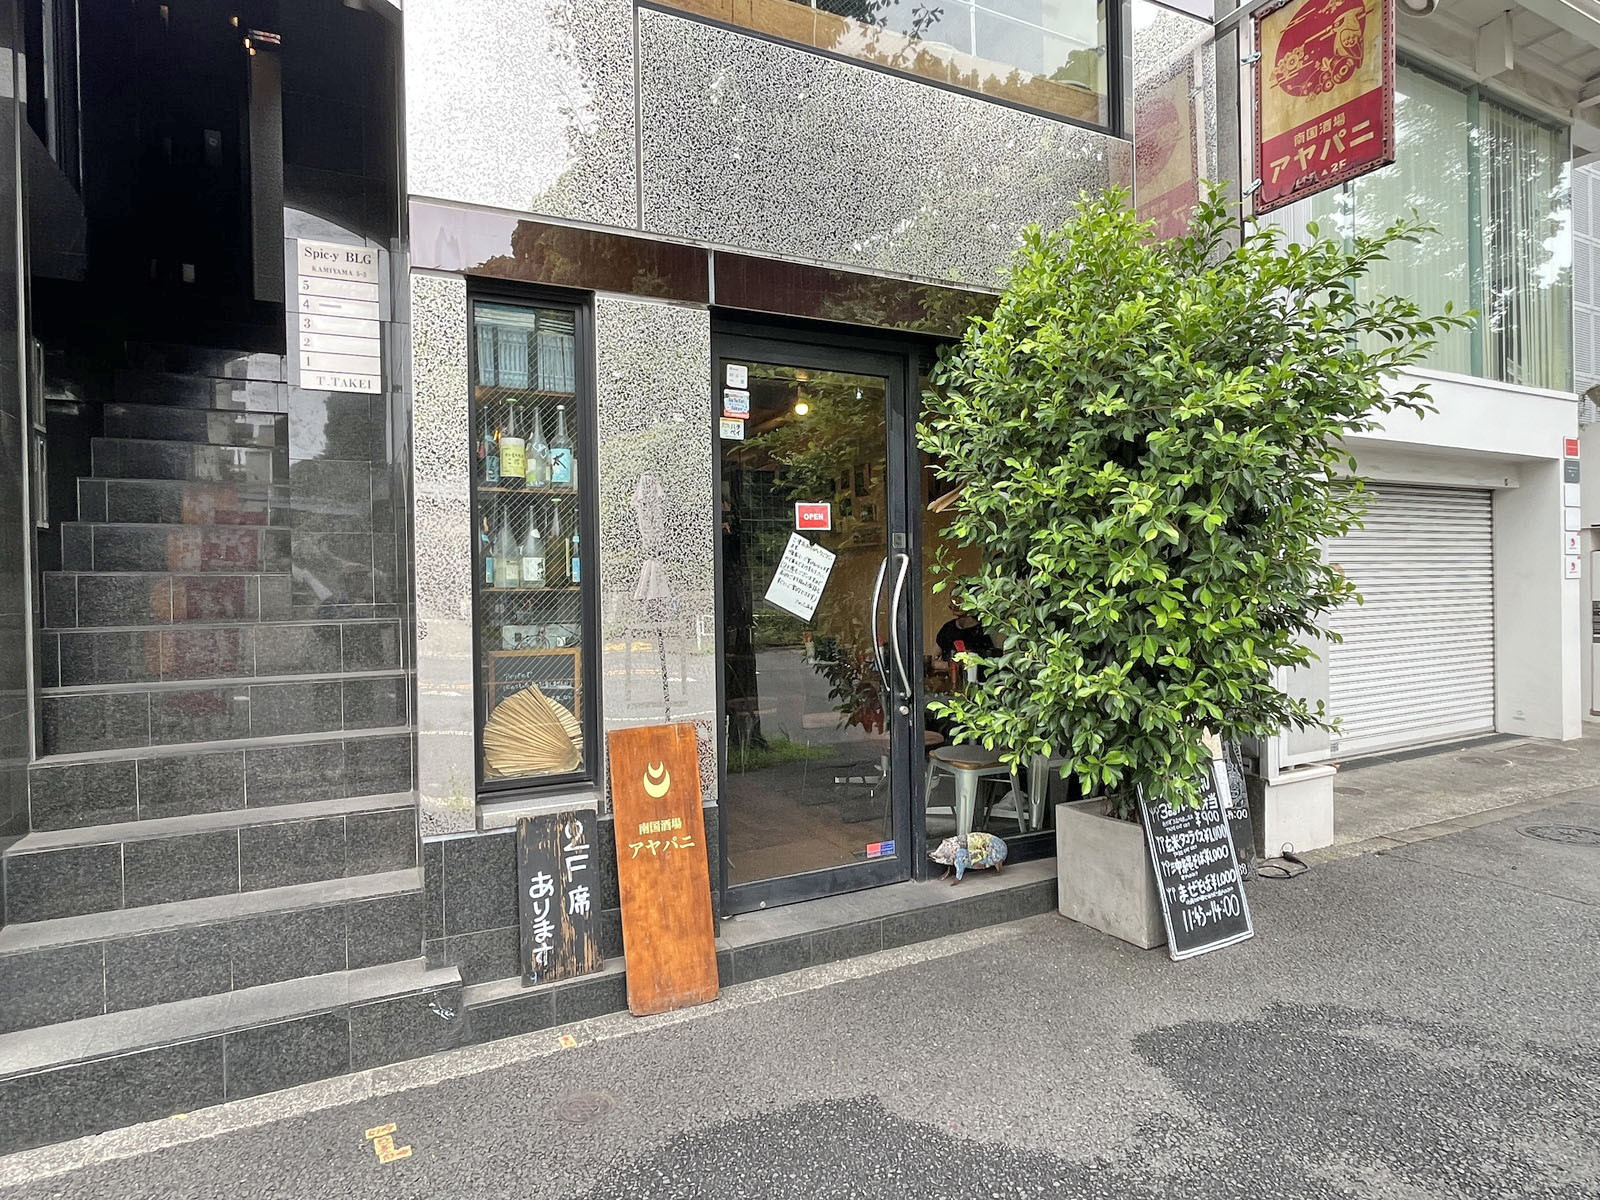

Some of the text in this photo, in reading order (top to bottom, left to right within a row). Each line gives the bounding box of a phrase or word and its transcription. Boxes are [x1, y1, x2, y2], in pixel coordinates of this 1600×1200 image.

[1293, 112, 1346, 147] 南国酒場
[1269, 120, 1374, 185] アヤパニ
[1330, 158, 1347, 173] 2F
[345, 252, 372, 265] BLG
[312, 265, 353, 276] KAMIYAMA
[302, 279, 310, 290] 5
[302, 299, 310, 310] 4
[303, 318, 311, 329] 3
[303, 337, 311, 347] 2
[305, 356, 311, 367] 1
[803, 512, 824, 521] OPEN
[1194, 810, 1220, 828] ¥900
[638, 819, 683, 835] 南国酒場
[628, 835, 695, 859] アヤパニ
[528, 871, 555, 966] あります
